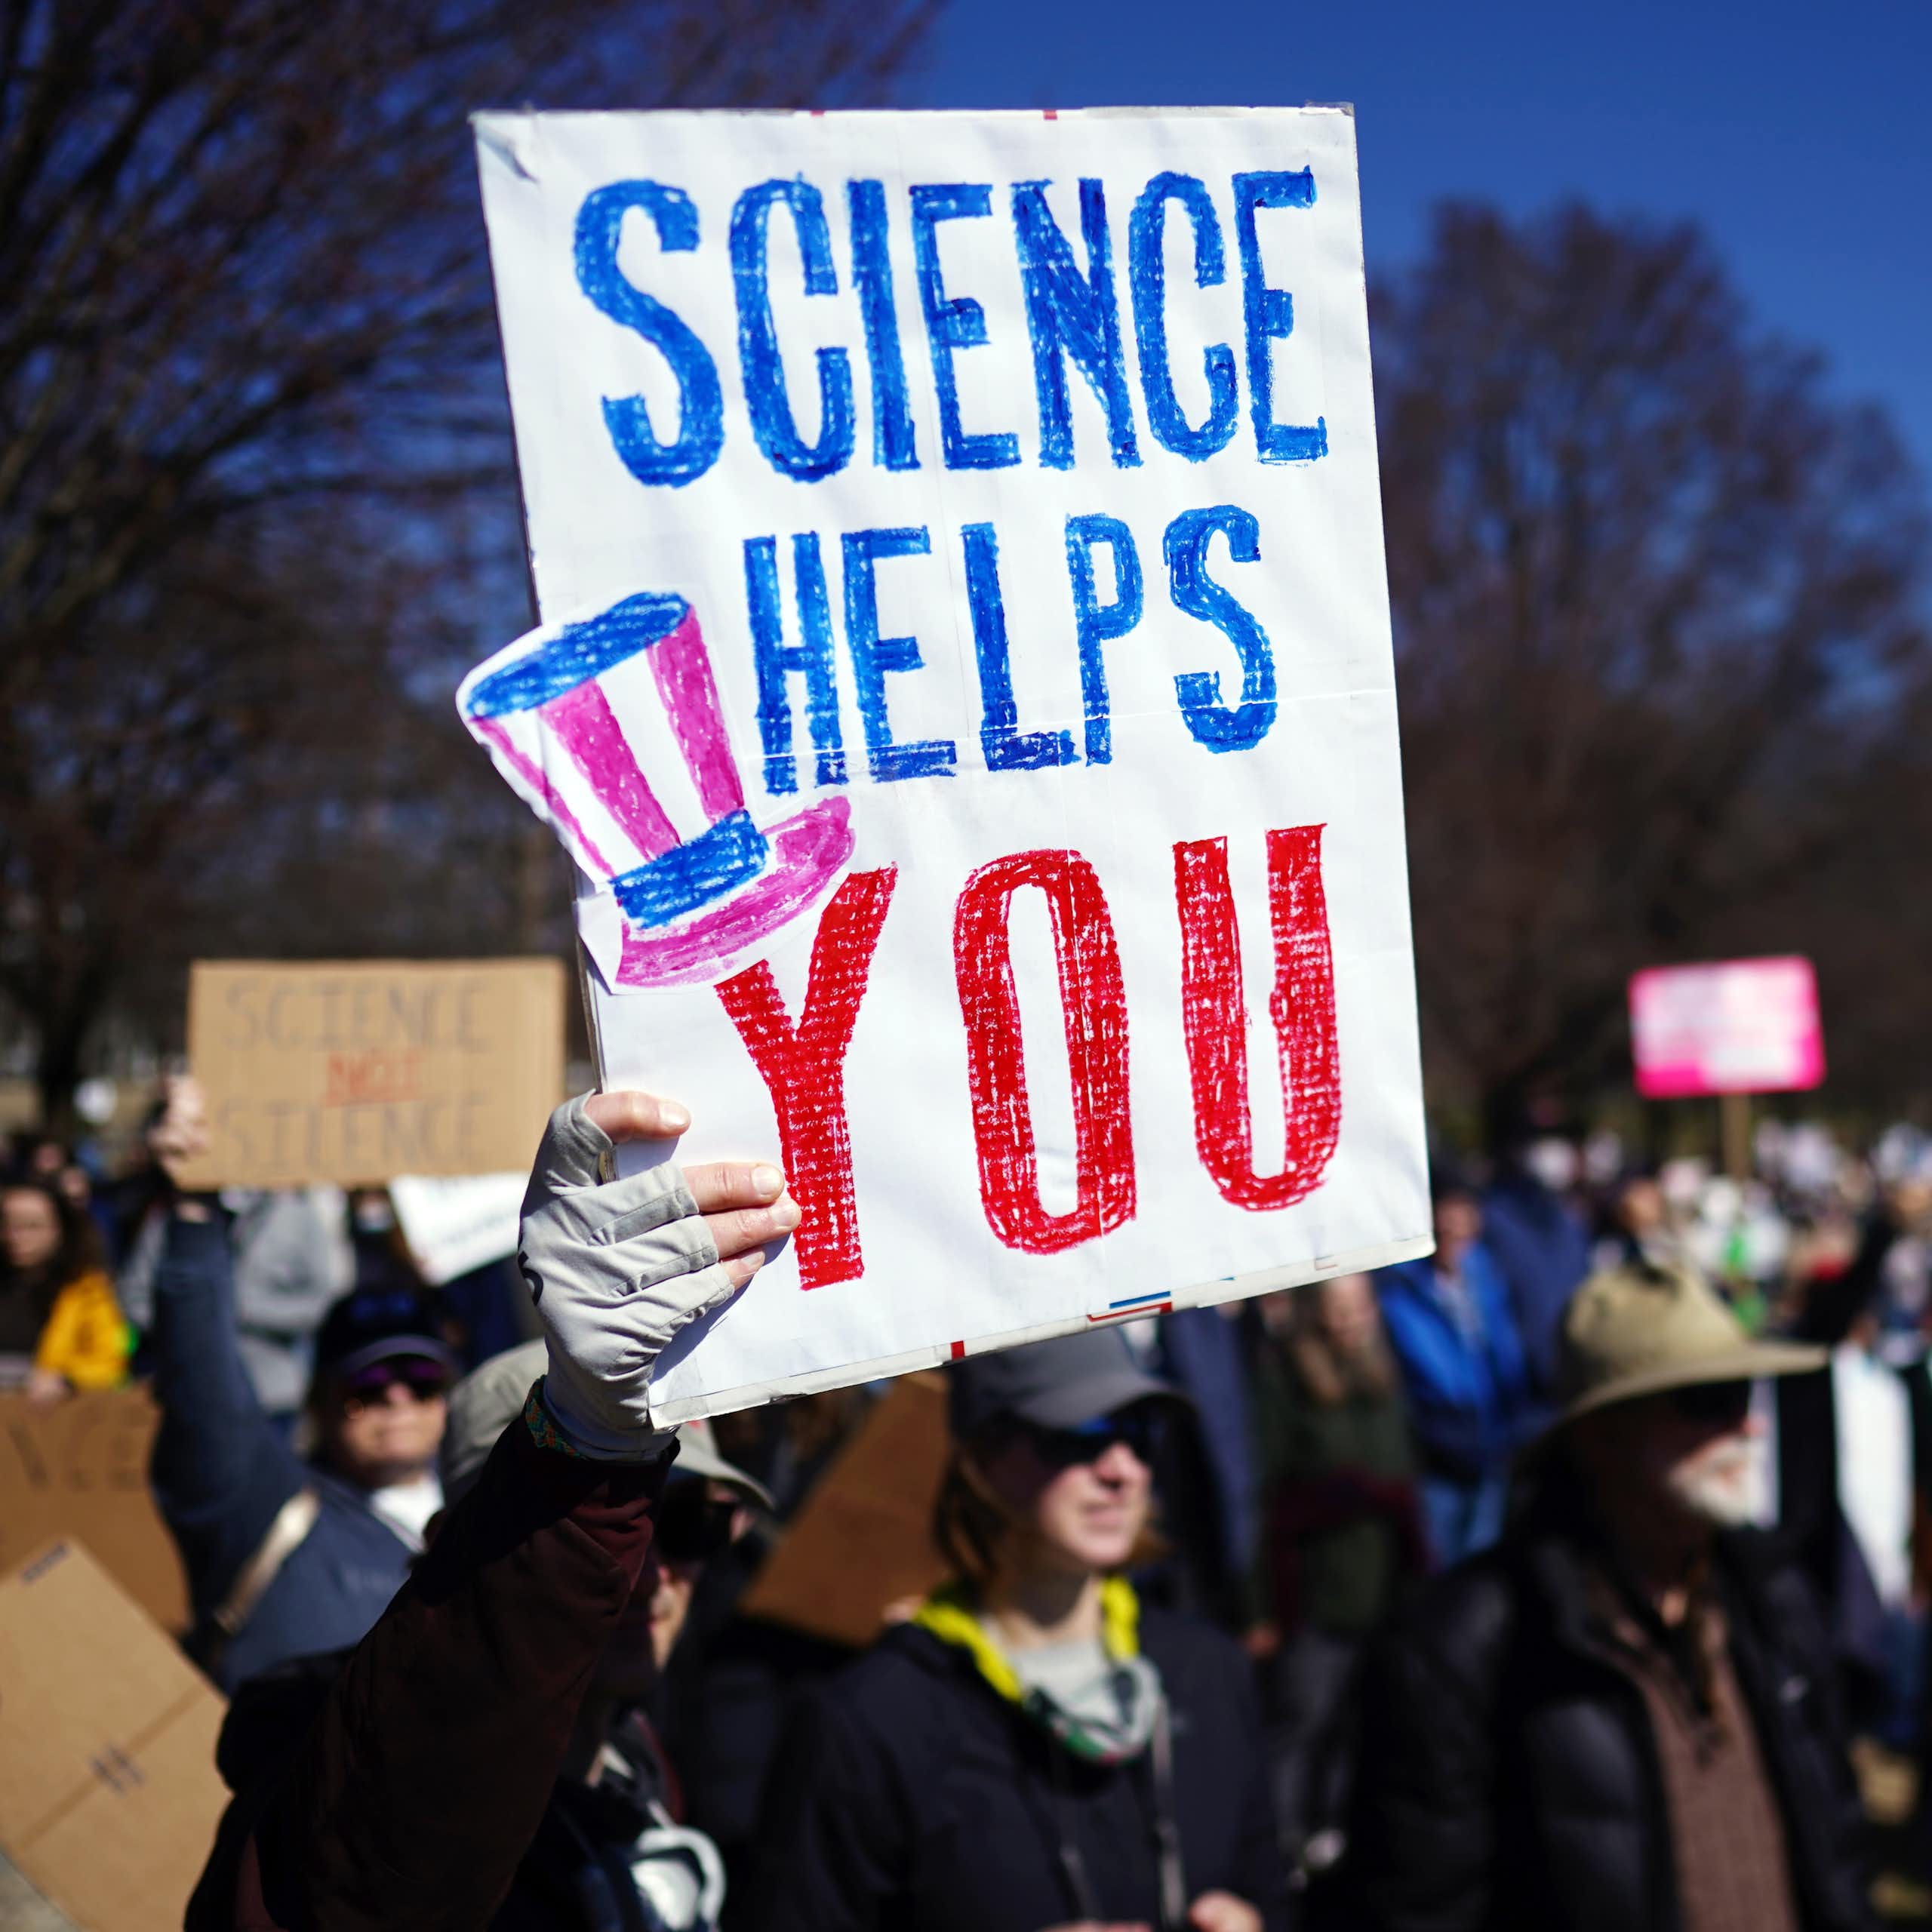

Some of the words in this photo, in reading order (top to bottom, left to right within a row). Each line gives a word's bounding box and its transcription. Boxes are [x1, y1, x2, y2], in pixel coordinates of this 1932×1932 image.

[574, 166, 1328, 487] SCIENCE
[743, 505, 1278, 795] HELPS
[223, 978, 492, 1053] SCIENCE
[325, 1052, 424, 1102] NOT
[718, 824, 1340, 1288] YOU
